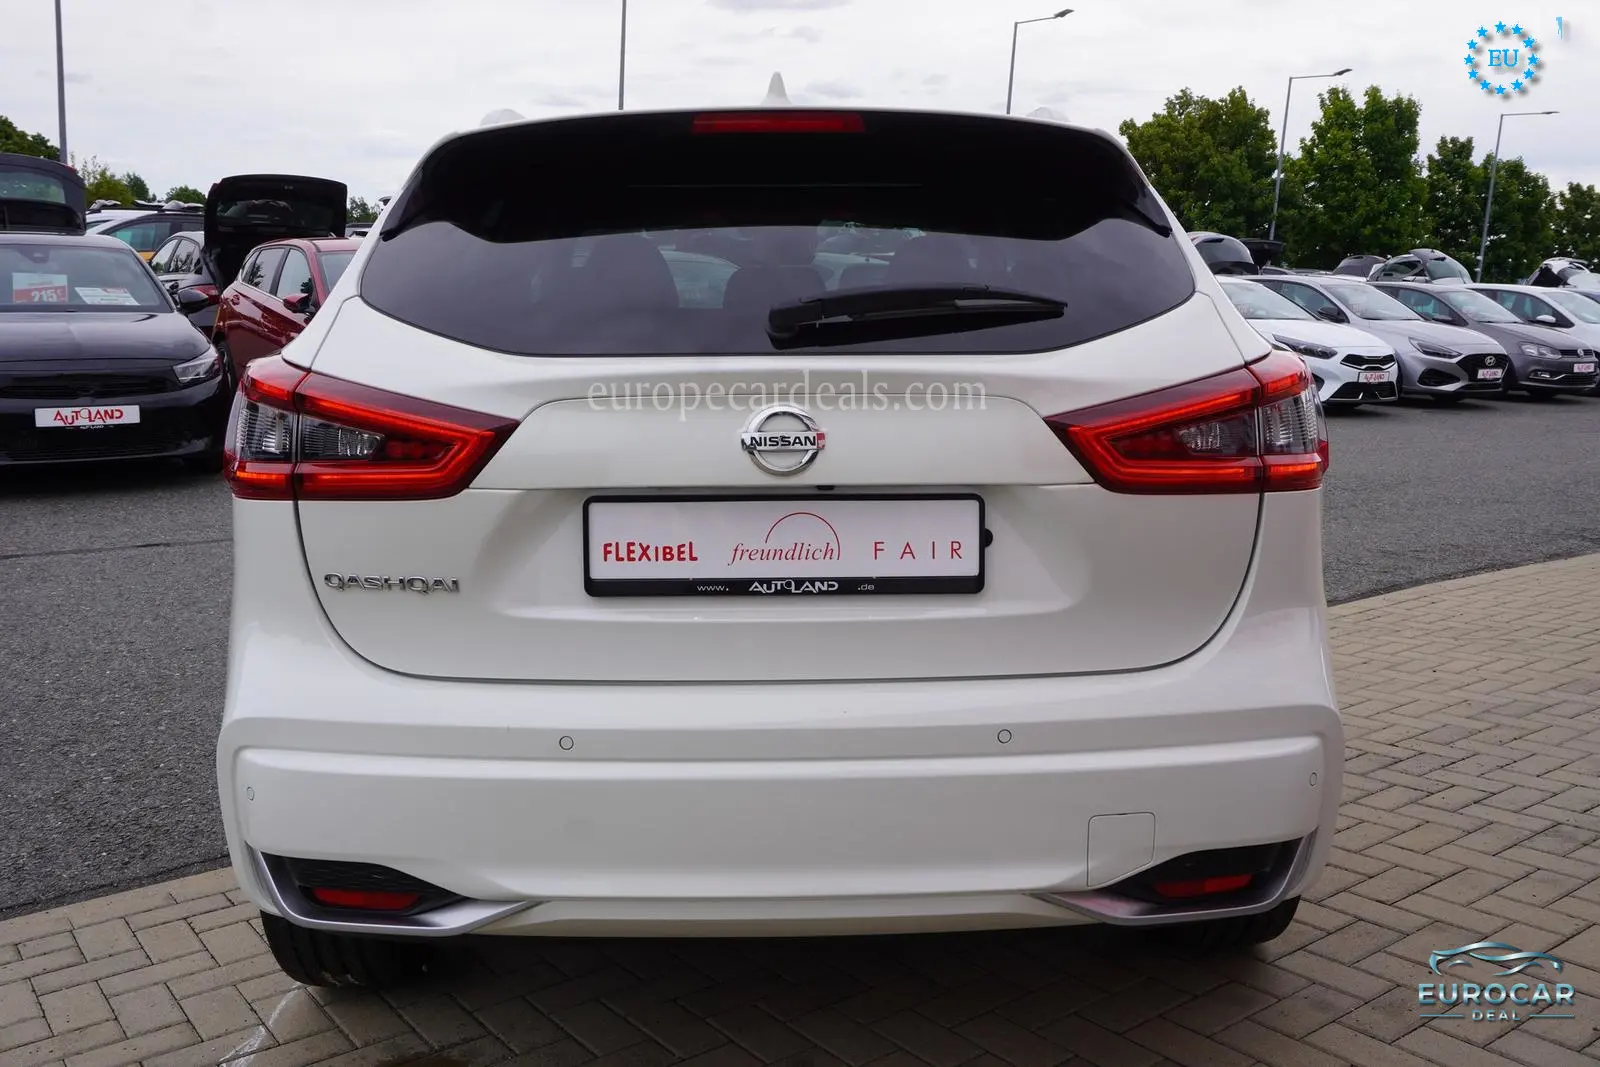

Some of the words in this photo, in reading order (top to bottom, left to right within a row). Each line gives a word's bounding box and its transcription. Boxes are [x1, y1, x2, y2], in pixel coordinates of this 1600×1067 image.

[53, 408, 124, 425] AUTOLAND
[750, 436, 816, 447] NISSAN
[603, 542, 698, 562] FLEXIBEL
[728, 541, 835, 566] freundlich
[874, 541, 962, 560] FAIR
[324, 572, 461, 594] QASHQAI
[749, 579, 839, 593] AUTOLAND
